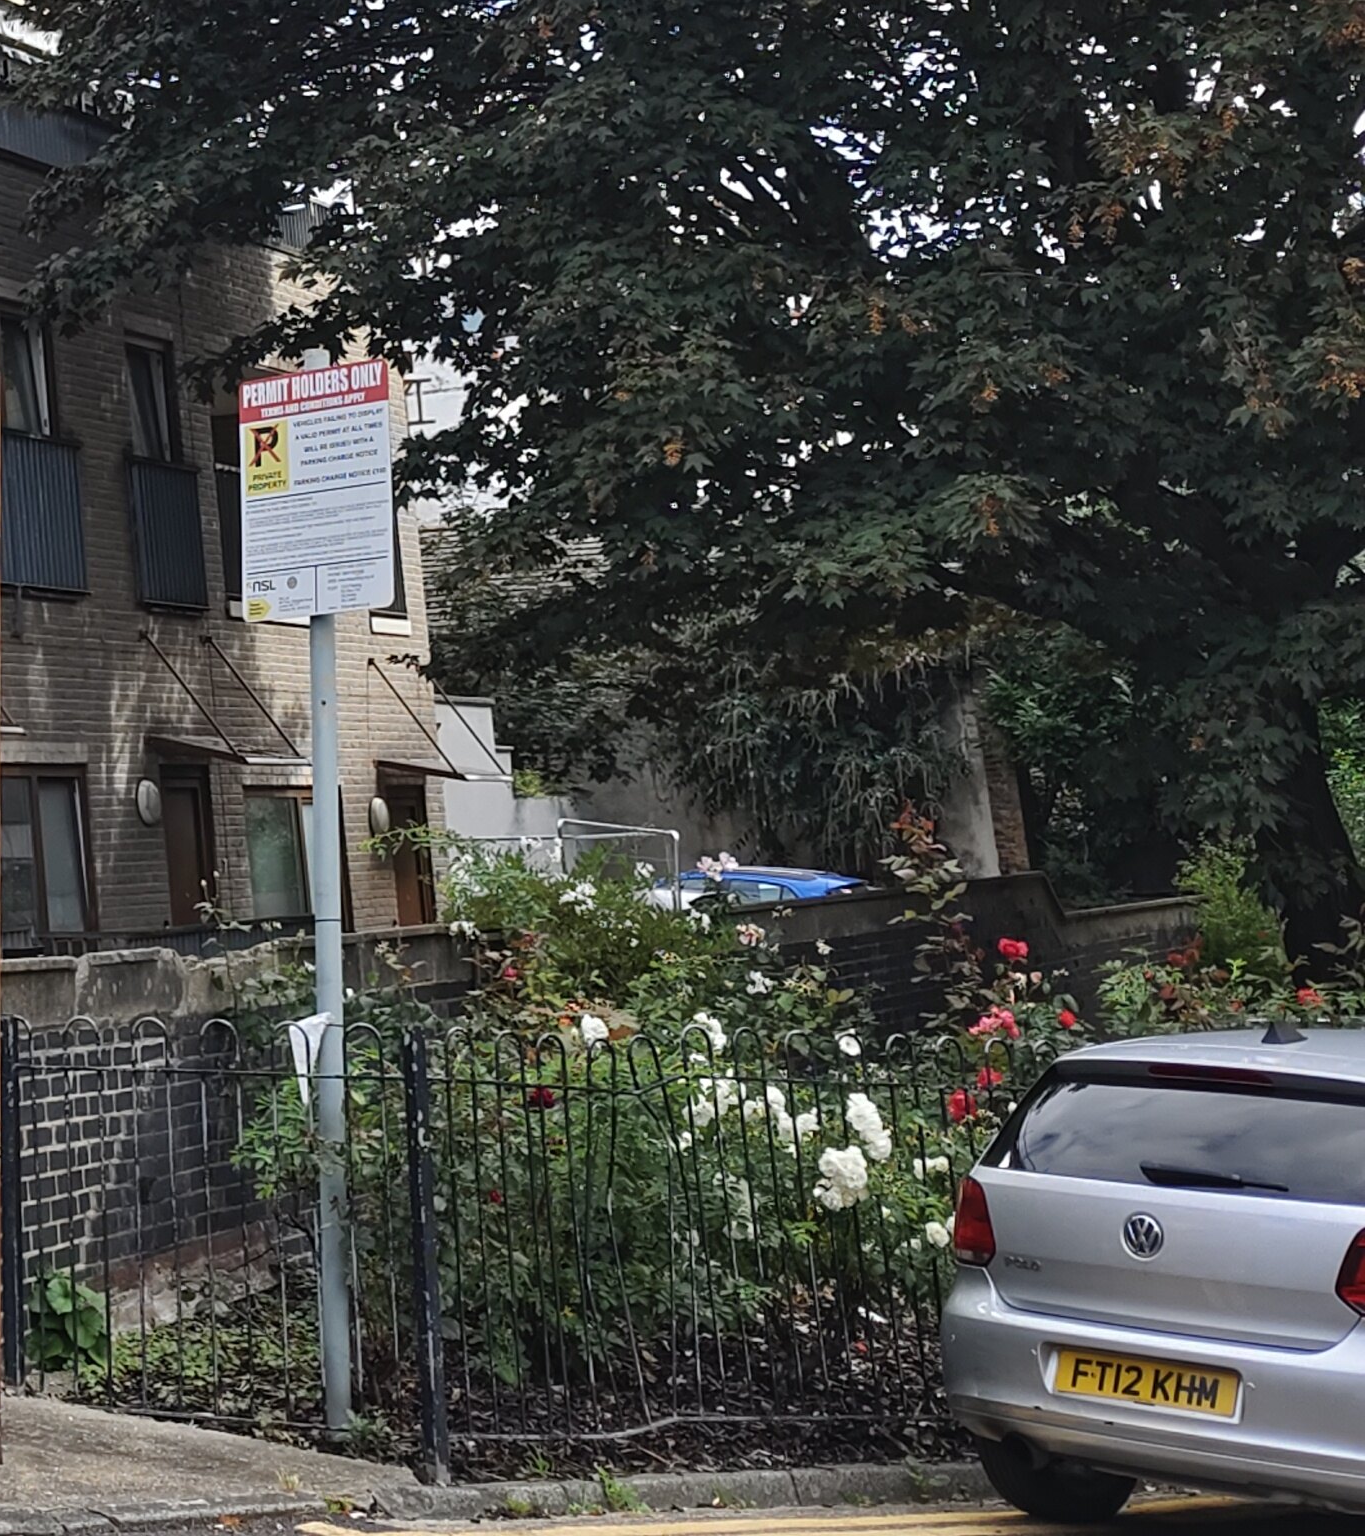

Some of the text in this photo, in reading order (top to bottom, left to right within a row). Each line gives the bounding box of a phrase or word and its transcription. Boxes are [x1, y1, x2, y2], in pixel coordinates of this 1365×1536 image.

[242, 361, 383, 408] PERMIT HOLDERS ONLY
[293, 417, 322, 427] VEHICLES
[323, 413, 346, 422] FAILING
[357, 407, 383, 417] DISPLAY
[300, 431, 317, 439] VALID
[319, 428, 341, 437] PERMIT
[351, 424, 363, 432] ALL
[364, 421, 383, 429] TIMES
[300, 449, 378, 466] PARKING CHARGE NOTICE
[252, 470, 282, 481] PRIVATE
[294, 476, 320, 485] PARKING
[321, 472, 347, 482] CHARGE
[348, 469, 371, 478] NOTICE
[248, 479, 286, 492] PROPERTY
[1004, 1255, 1042, 1272] POLO
[1071, 1357, 1220, 1410] FT12 KHM
